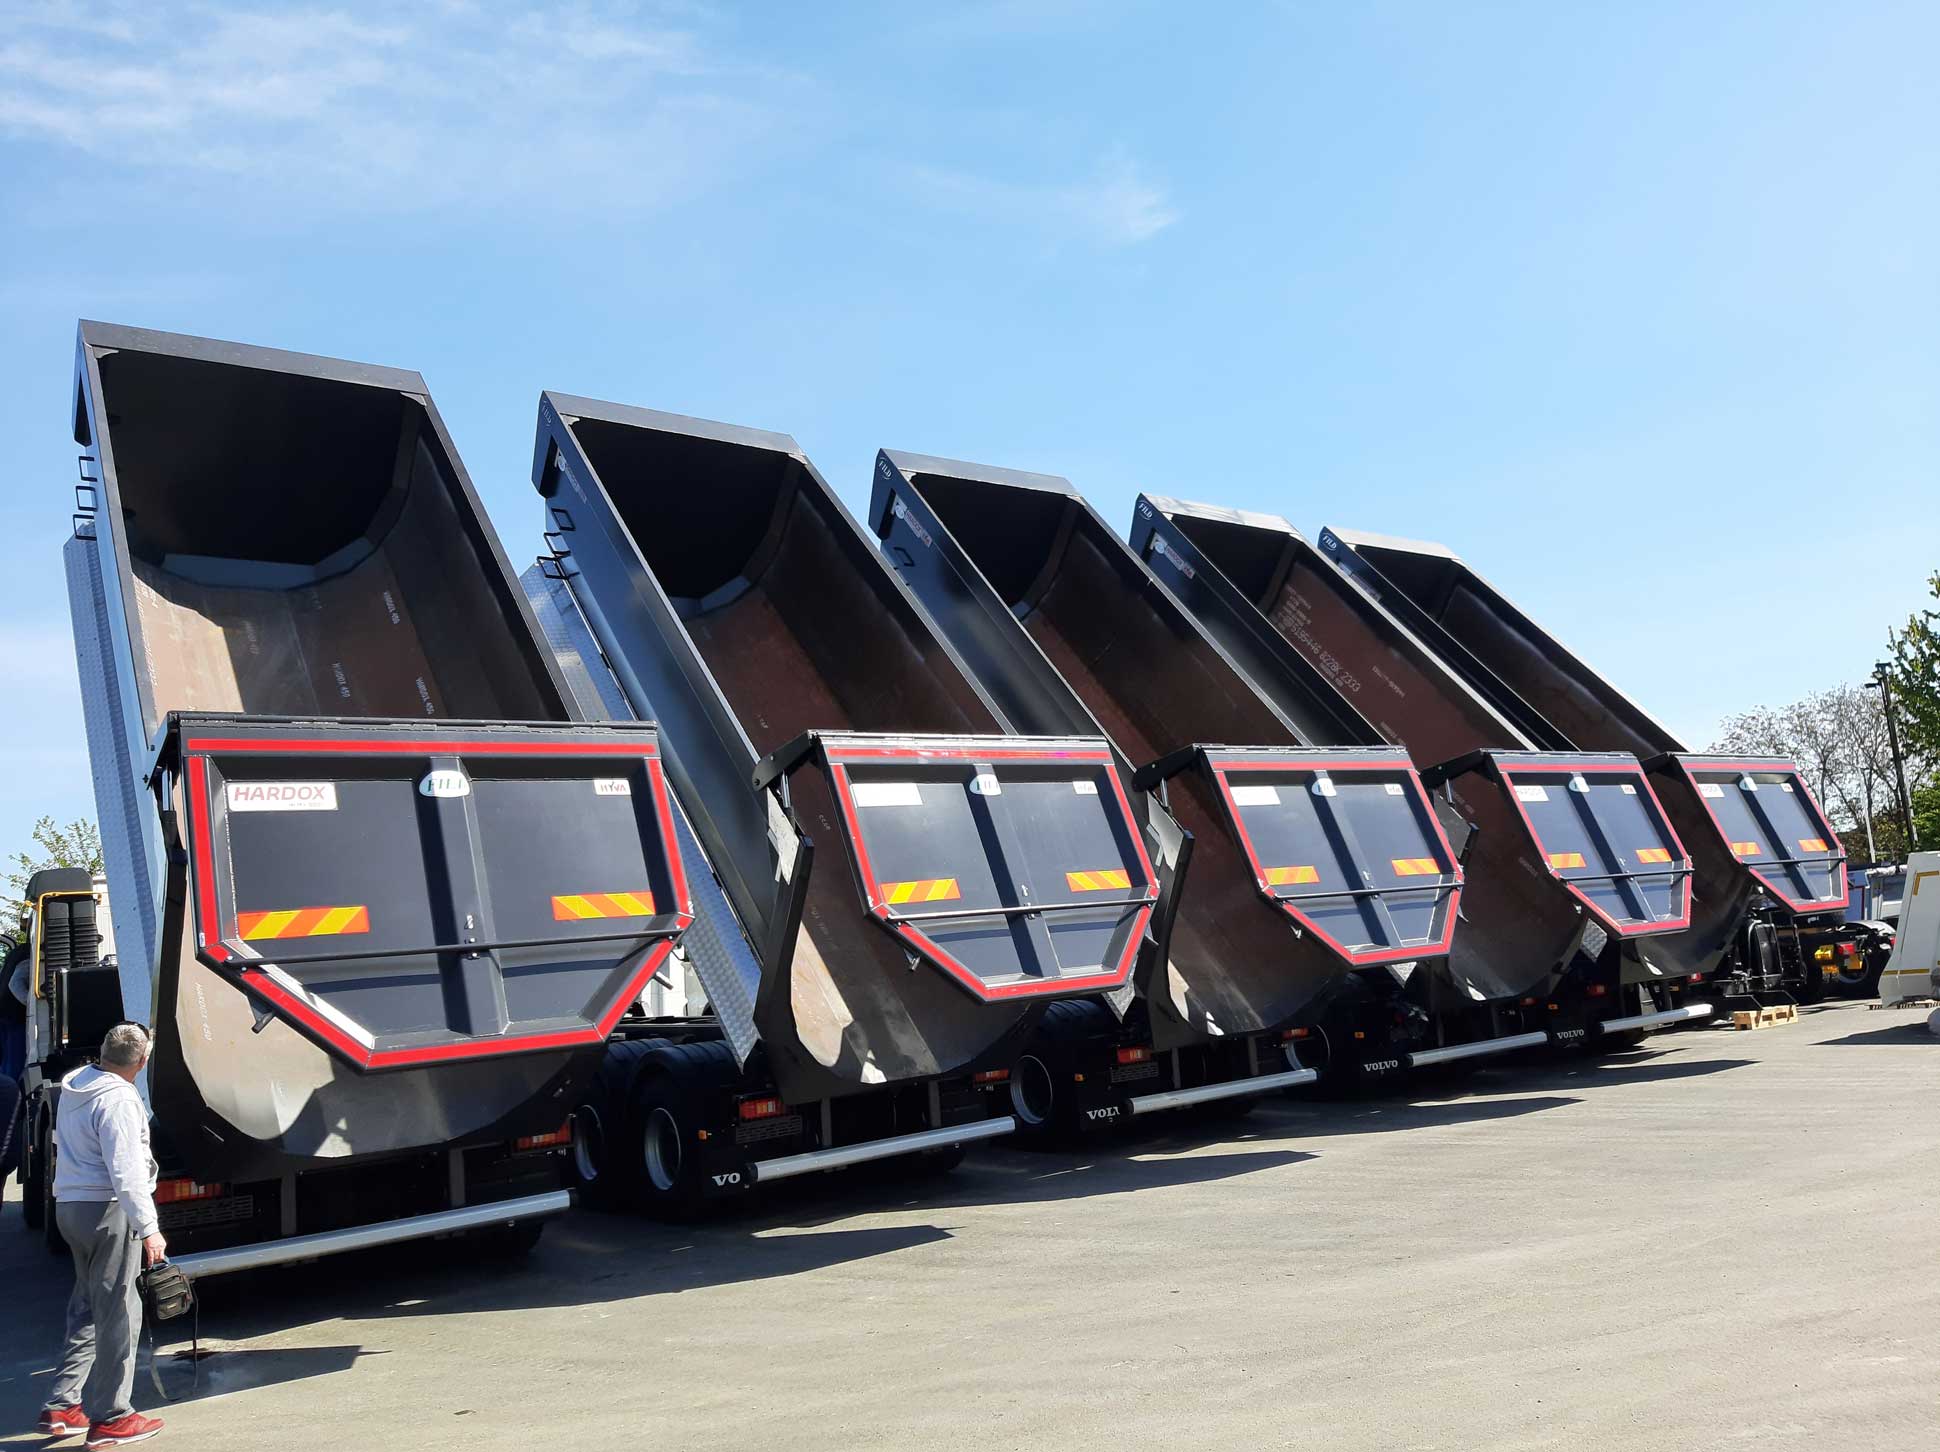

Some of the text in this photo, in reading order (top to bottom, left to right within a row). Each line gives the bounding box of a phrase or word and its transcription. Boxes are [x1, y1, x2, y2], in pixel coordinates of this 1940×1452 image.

[878, 460, 892, 478] FILD
[1138, 502, 1153, 519] FILD
[1322, 535, 1337, 549] FILD
[234, 786, 326, 801] HARDOX
[1556, 1029, 1584, 1039] VOLVO
[1363, 1060, 1398, 1072] VOLVO
[1086, 1106, 1121, 1120] VOL
